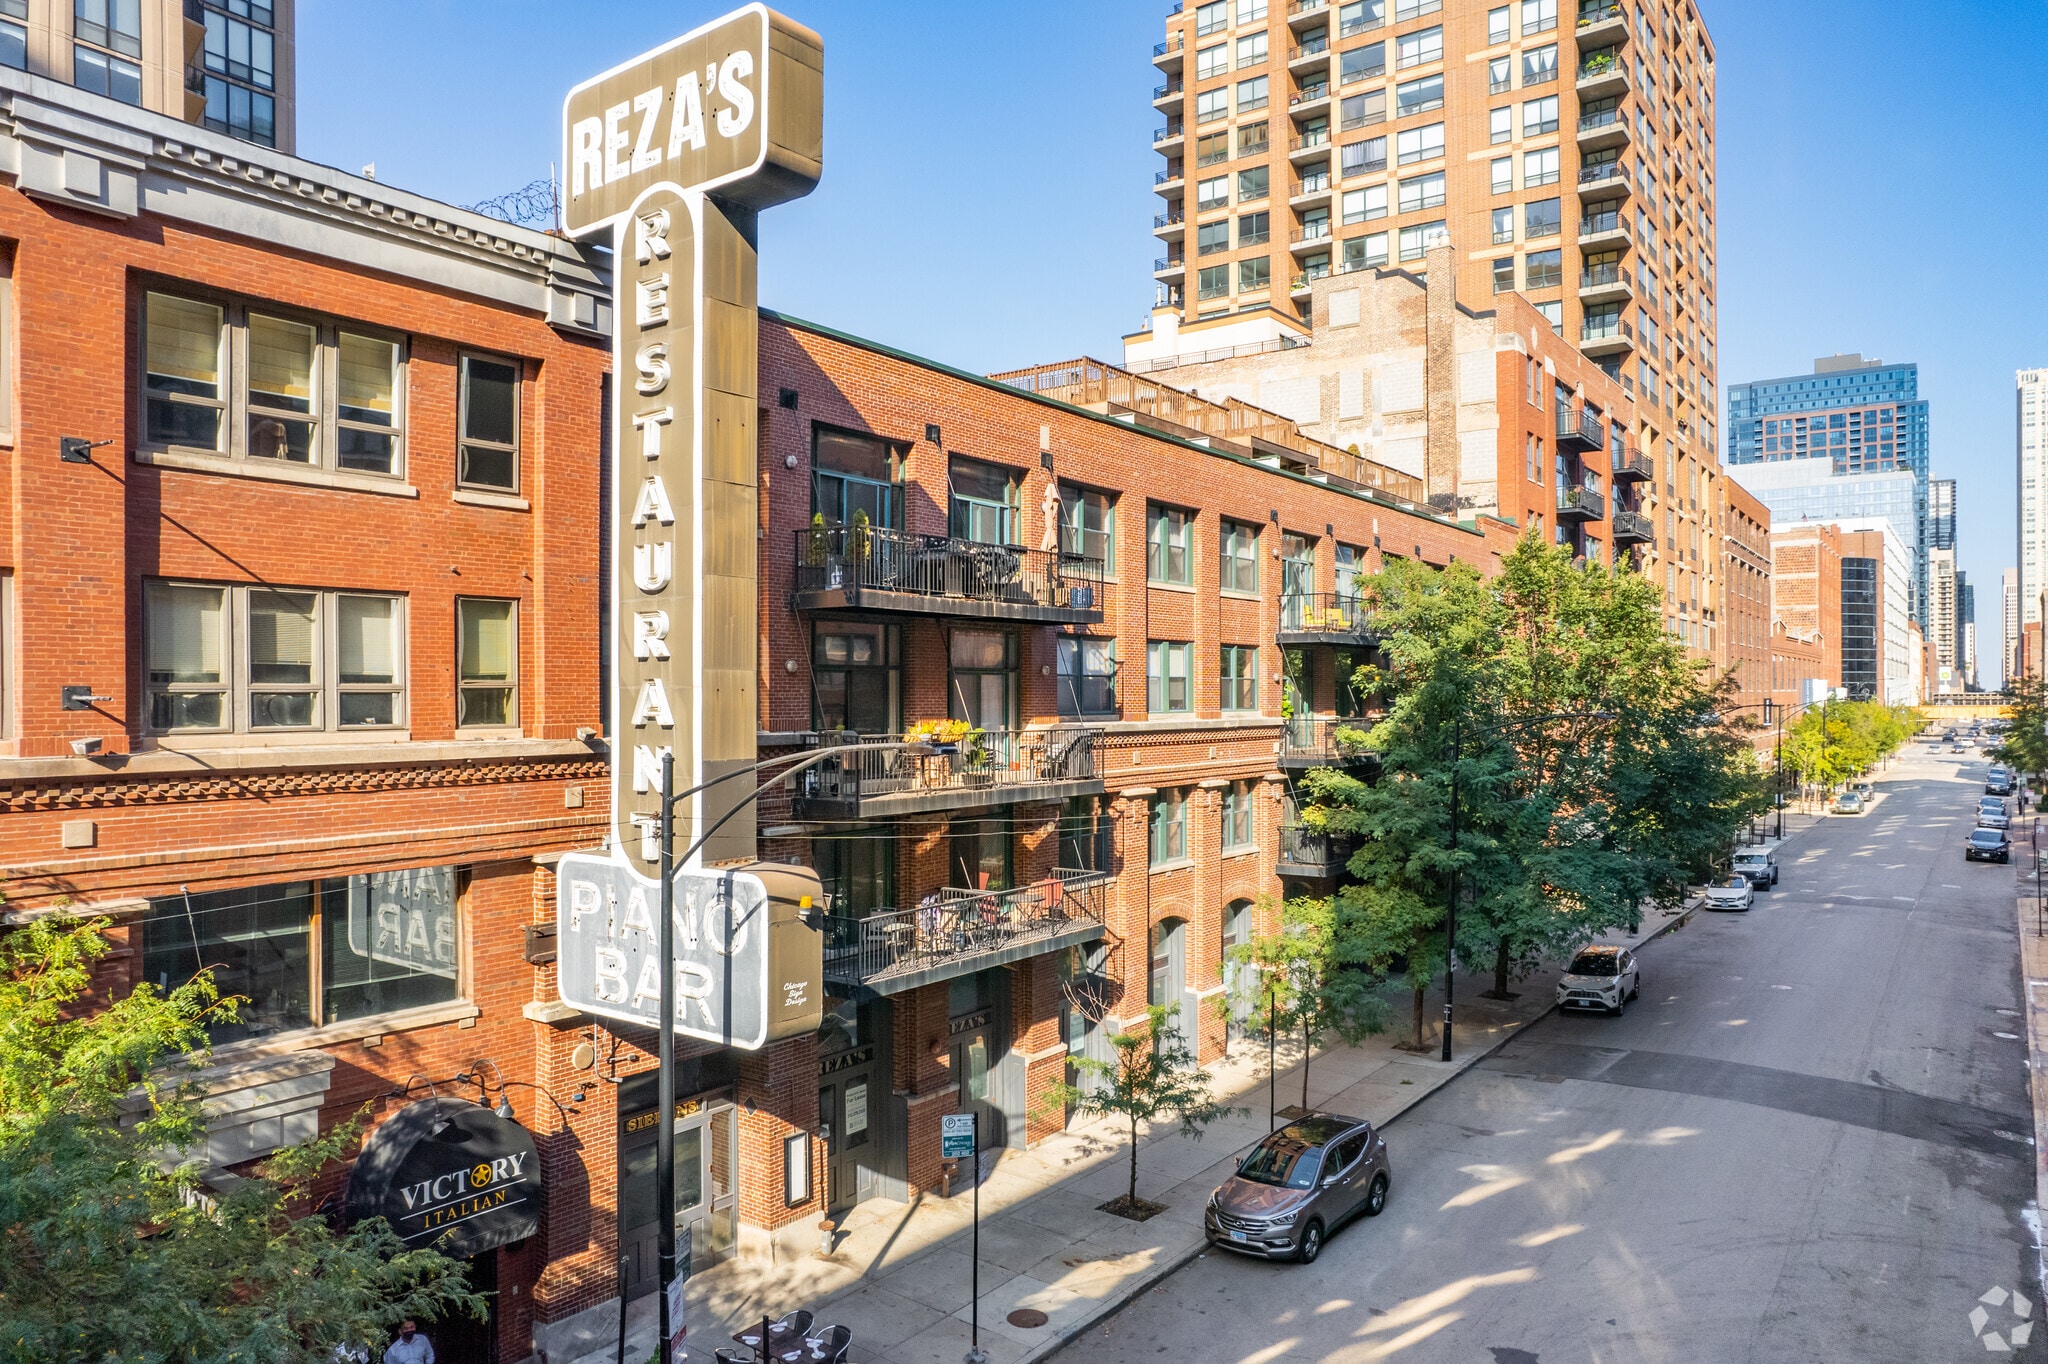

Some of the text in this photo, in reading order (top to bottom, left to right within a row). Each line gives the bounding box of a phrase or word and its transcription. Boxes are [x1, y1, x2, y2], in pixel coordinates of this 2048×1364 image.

[572, 50, 754, 198] REZA'S
[630, 208, 675, 861] RESTAURANT
[571, 880, 748, 957] PIANO
[595, 946, 716, 1027] BAR
[784, 981, 808, 991] Chicago
[784, 997, 807, 1006] Design
[788, 990, 803, 999] Sign
[400, 1151, 527, 1210] VICTORY
[424, 1190, 506, 1229] ITALIAN
